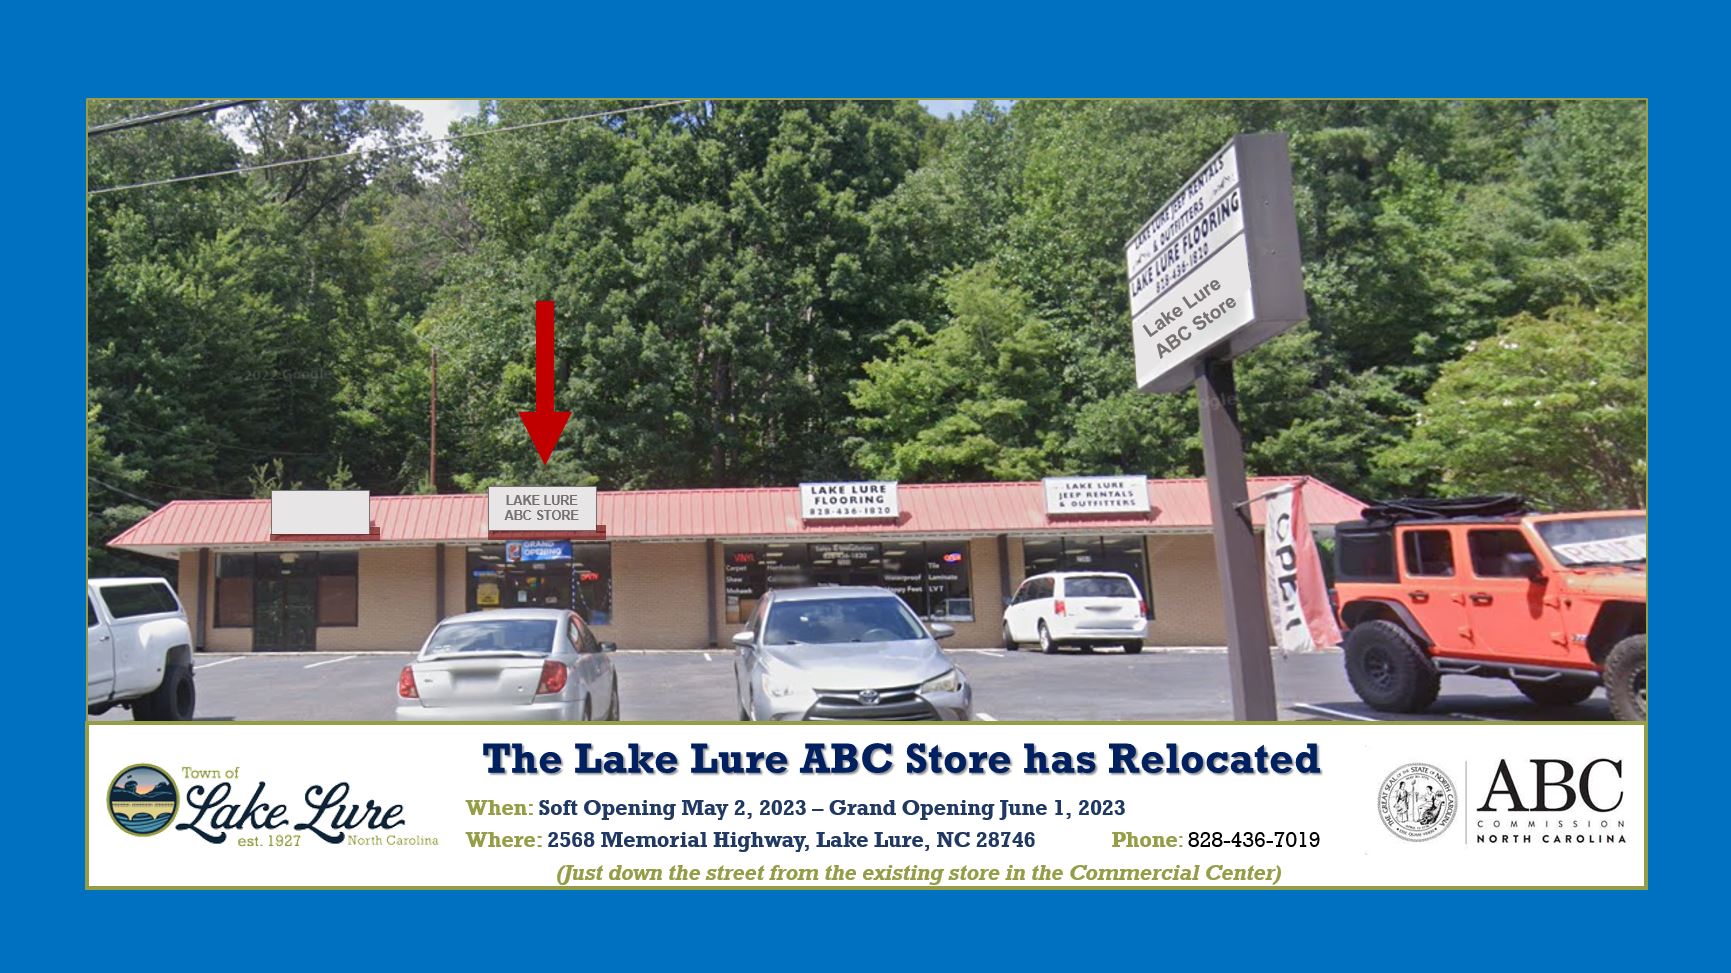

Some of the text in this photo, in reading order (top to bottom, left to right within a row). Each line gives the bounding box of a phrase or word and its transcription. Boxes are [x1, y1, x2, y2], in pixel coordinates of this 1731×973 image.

[1160, 197, 1205, 246] OUTFITTERS
[1131, 191, 1240, 297] LAKE LURE FLOORING
[1142, 278, 1222, 338] Lake Lure
[1156, 297, 1237, 359] ABC Store
[811, 484, 887, 495] LAKE LURE
[1066, 481, 1124, 490] LAKE LURE
[506, 494, 578, 506] LAKE LURE
[814, 495, 884, 505] FLOORING
[1059, 490, 1134, 500] JEEP RENTALS
[1071, 499, 1136, 508] OUTFITTERS
[504, 509, 579, 521] ABC STORE
[809, 506, 891, 516] 828-436-1820
[884, 574, 922, 582] Waterproof
